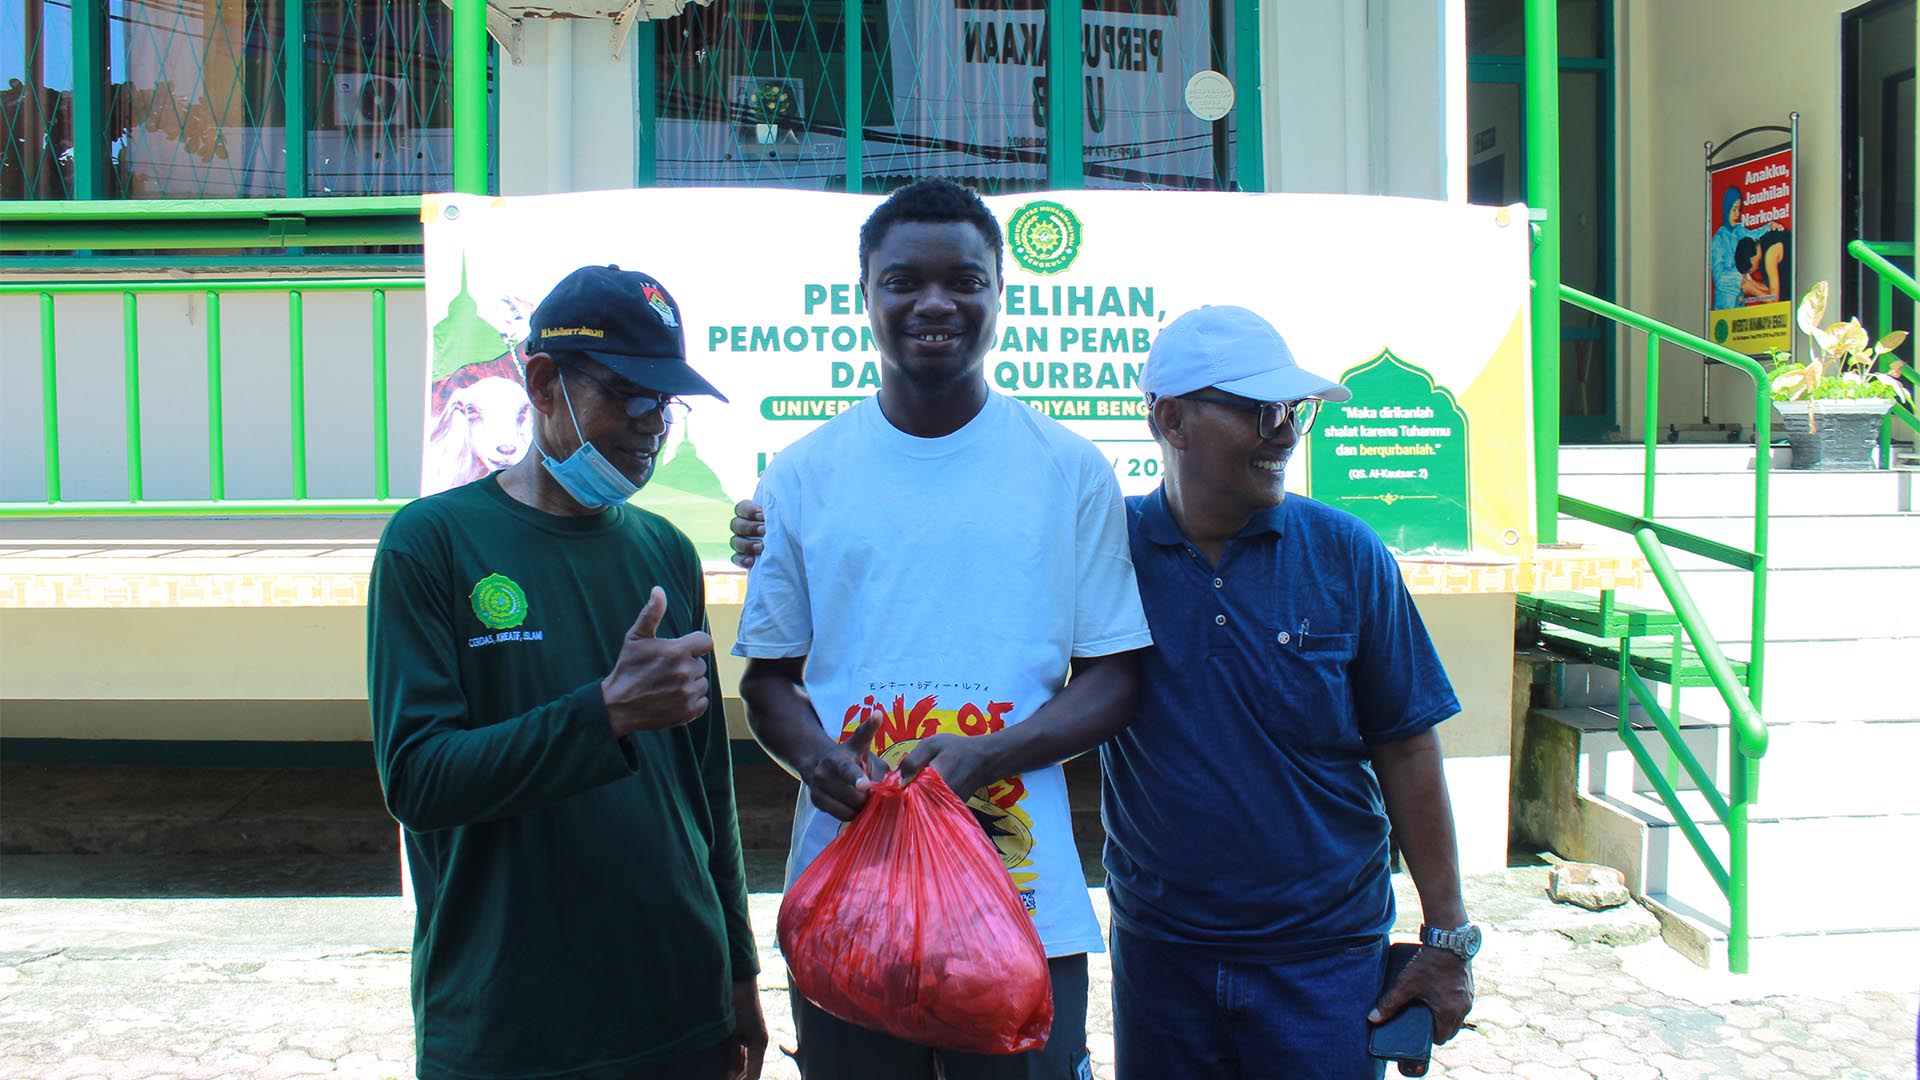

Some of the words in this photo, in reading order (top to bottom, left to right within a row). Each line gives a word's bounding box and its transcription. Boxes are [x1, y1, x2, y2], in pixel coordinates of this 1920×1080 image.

[1745, 164, 1790, 185] Anakku,
[1743, 182, 1790, 206] Jauhilah
[1741, 203, 1790, 227] Narkoba!
[991, 326, 1048, 352] AN
[831, 361, 882, 389] DA
[1096, 400, 1151, 417] BENG
[1379, 406, 1434, 419] dirikanlah
[1324, 425, 1359, 438] shalat
[1360, 425, 1398, 438] karena
[1399, 425, 1451, 437] Tuhanmu
[1336, 444, 1358, 456] dan
[1127, 458, 1166, 477] 20
[1348, 469, 1368, 480] (QS.
[1418, 468, 1428, 480] 2)
[468, 635, 496, 648] CERDAS,
[496, 631, 523, 642] KREATIF,
[523, 630, 543, 641] ISLAMI
